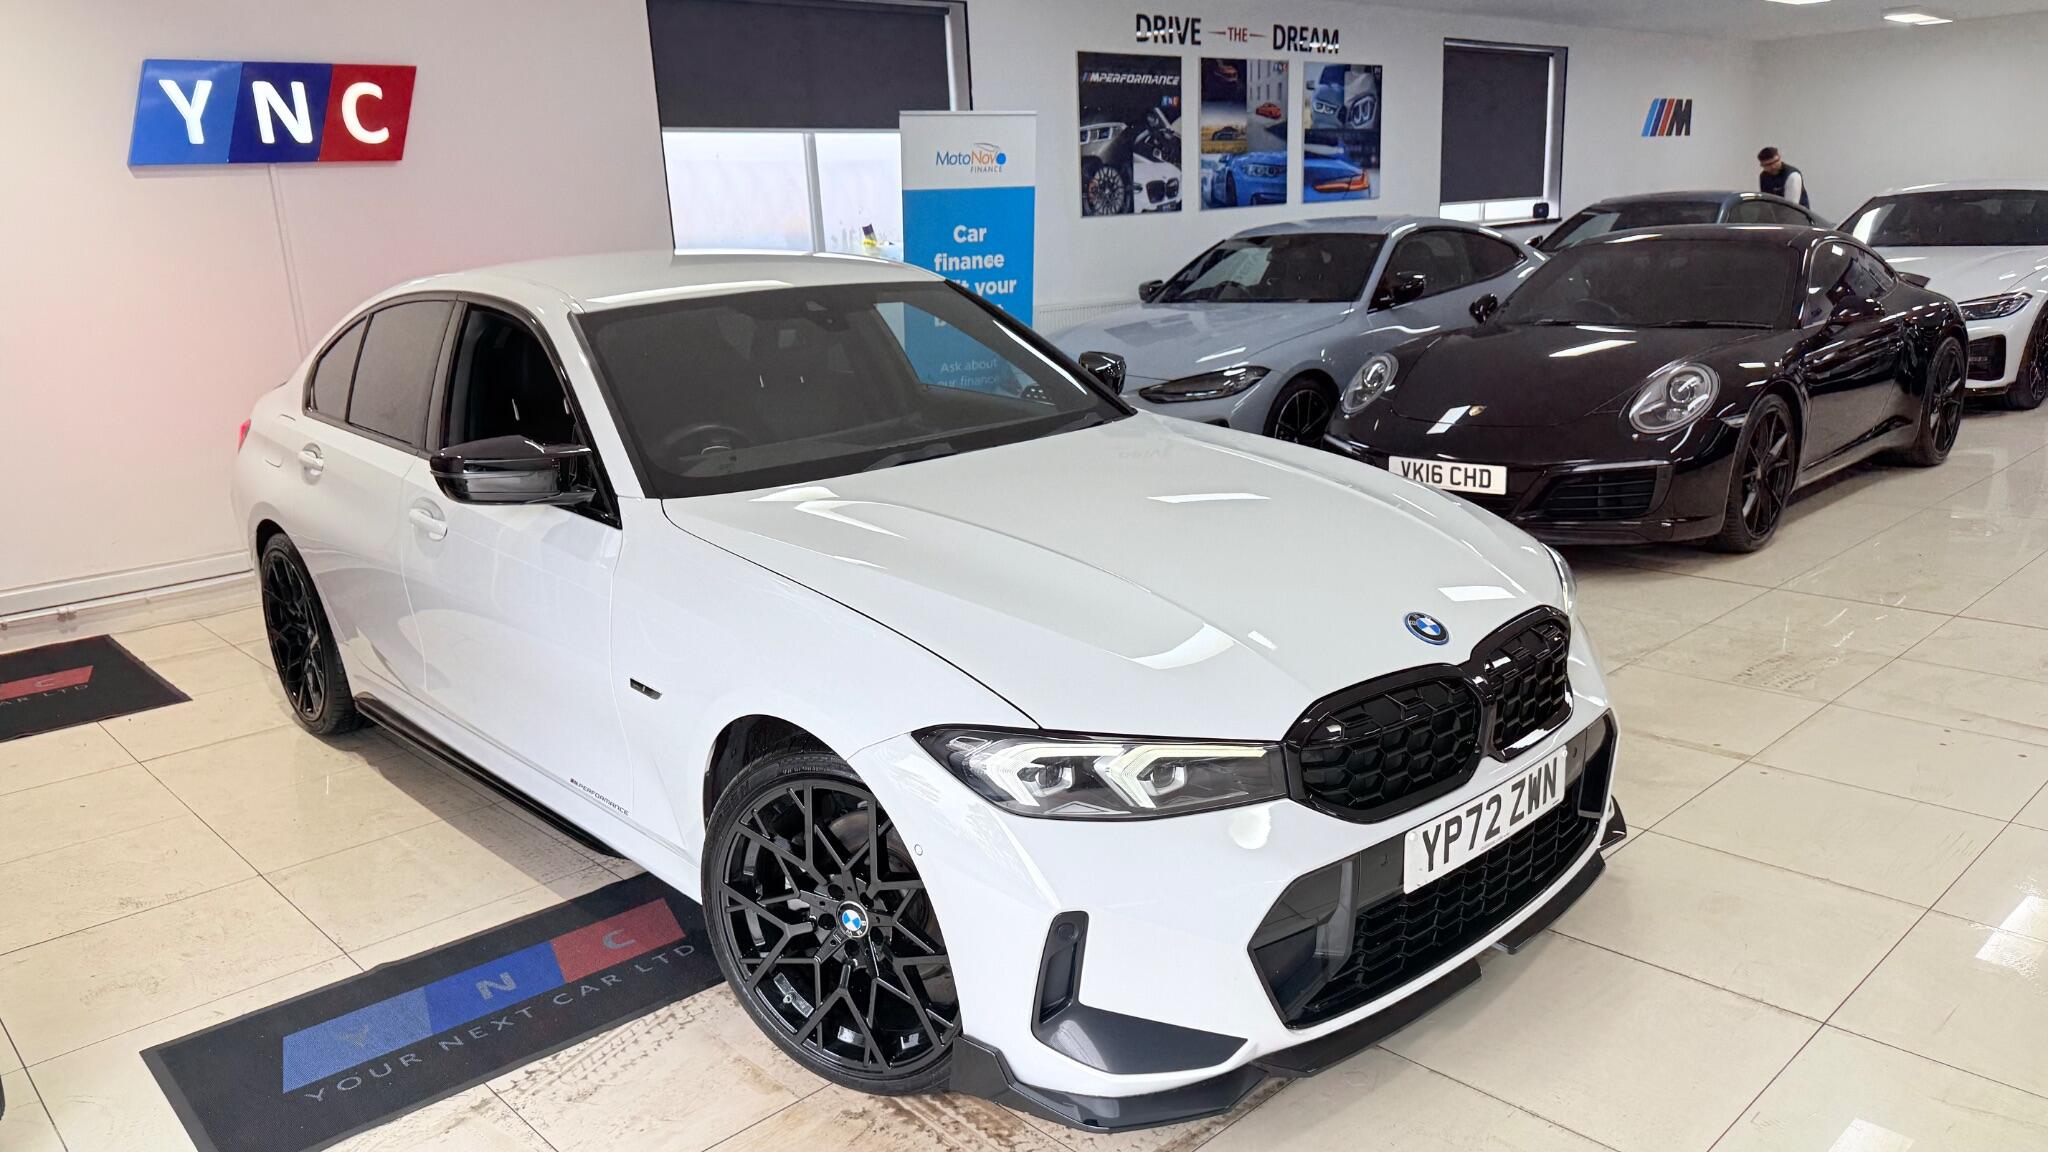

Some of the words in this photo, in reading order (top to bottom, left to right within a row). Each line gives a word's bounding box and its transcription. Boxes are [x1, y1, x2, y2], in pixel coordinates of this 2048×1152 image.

[1136, 13, 1202, 46] DRIVE
[1227, 27, 1248, 43] THE
[1273, 24, 1340, 54] DREAM
[159, 79, 390, 145] YNC
[936, 150, 1007, 167] MotoNovo
[970, 166, 1003, 174] FINANCE
[953, 225, 987, 243] Car
[934, 252, 1005, 272] finance
[974, 278, 1017, 297] your
[941, 361, 961, 374] Ask
[964, 359, 998, 371] about
[1401, 460, 1443, 484] VK16
[1450, 466, 1492, 489] CHD
[1422, 793, 1502, 873] YP72
[1509, 756, 1557, 827] ZWN
[304, 1052, 423, 1103] YOUR
[438, 1006, 532, 1052] NEXT
[553, 973, 623, 1006] CAR
[635, 944, 696, 974] LTD
